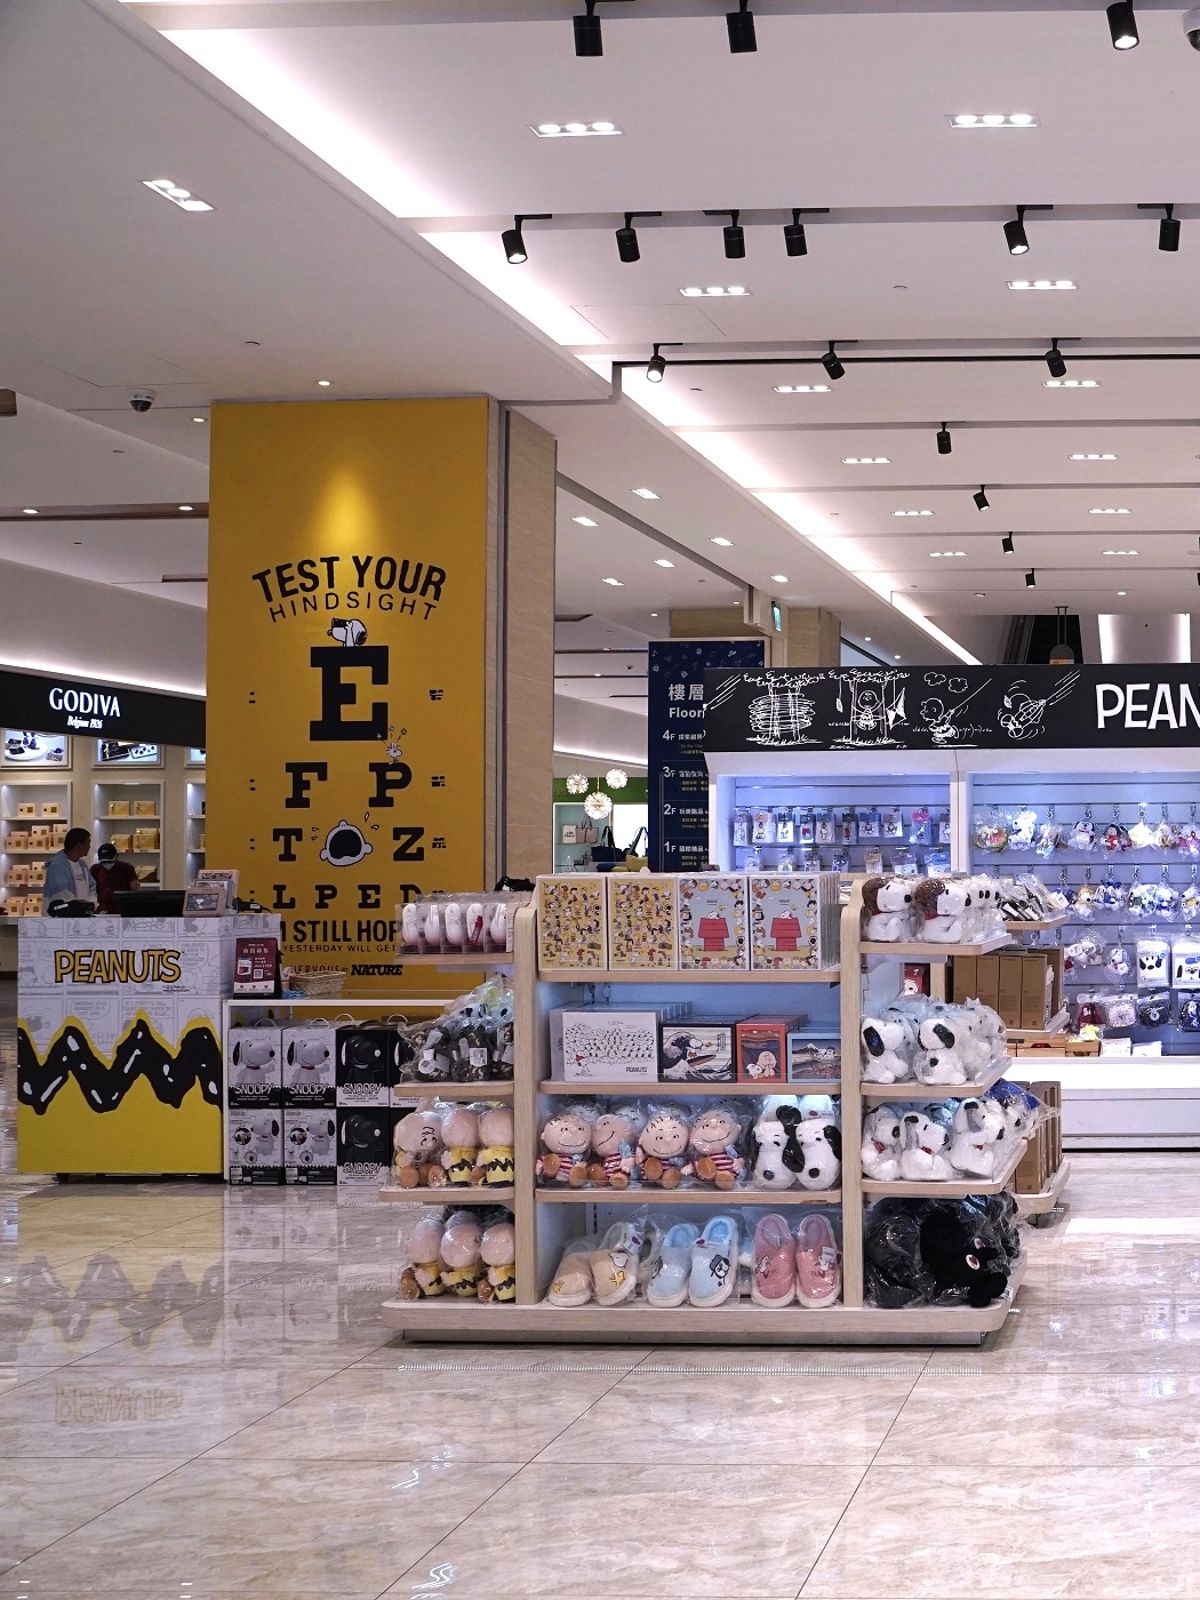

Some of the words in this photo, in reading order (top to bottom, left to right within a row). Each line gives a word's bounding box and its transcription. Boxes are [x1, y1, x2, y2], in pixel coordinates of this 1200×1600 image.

[252, 556, 340, 602] TEST
[352, 555, 446, 601] YOUR
[270, 591, 437, 623] HINDSIGHT
[309, 645, 389, 741] E
[668, 684, 704, 701] 樓層
[49, 687, 121, 717] GODIVA
[669, 707, 703, 718] Floor
[662, 729, 676, 741] 4F
[663, 766, 676, 778] 3F
[285, 762, 328, 808] F
[368, 762, 412, 807] P
[663, 804, 676, 815] 2F
[273, 828, 303, 861] T
[393, 827, 424, 861] Z
[664, 841, 677, 853] 1F
[273, 885, 296, 909] L
[315, 885, 338, 909] P
[358, 885, 381, 909] E
[293, 920, 352, 942] STILL
[357, 920, 402, 942] HOP
[54, 948, 182, 983] PEANUTS
[351, 965, 403, 976] NATURE
[235, 1082, 272, 1095] SNOOPY
[289, 1082, 328, 1095] SNOOPY
[343, 1082, 382, 1095] SNOOPY
[343, 1161, 382, 1174] SNOOPY
